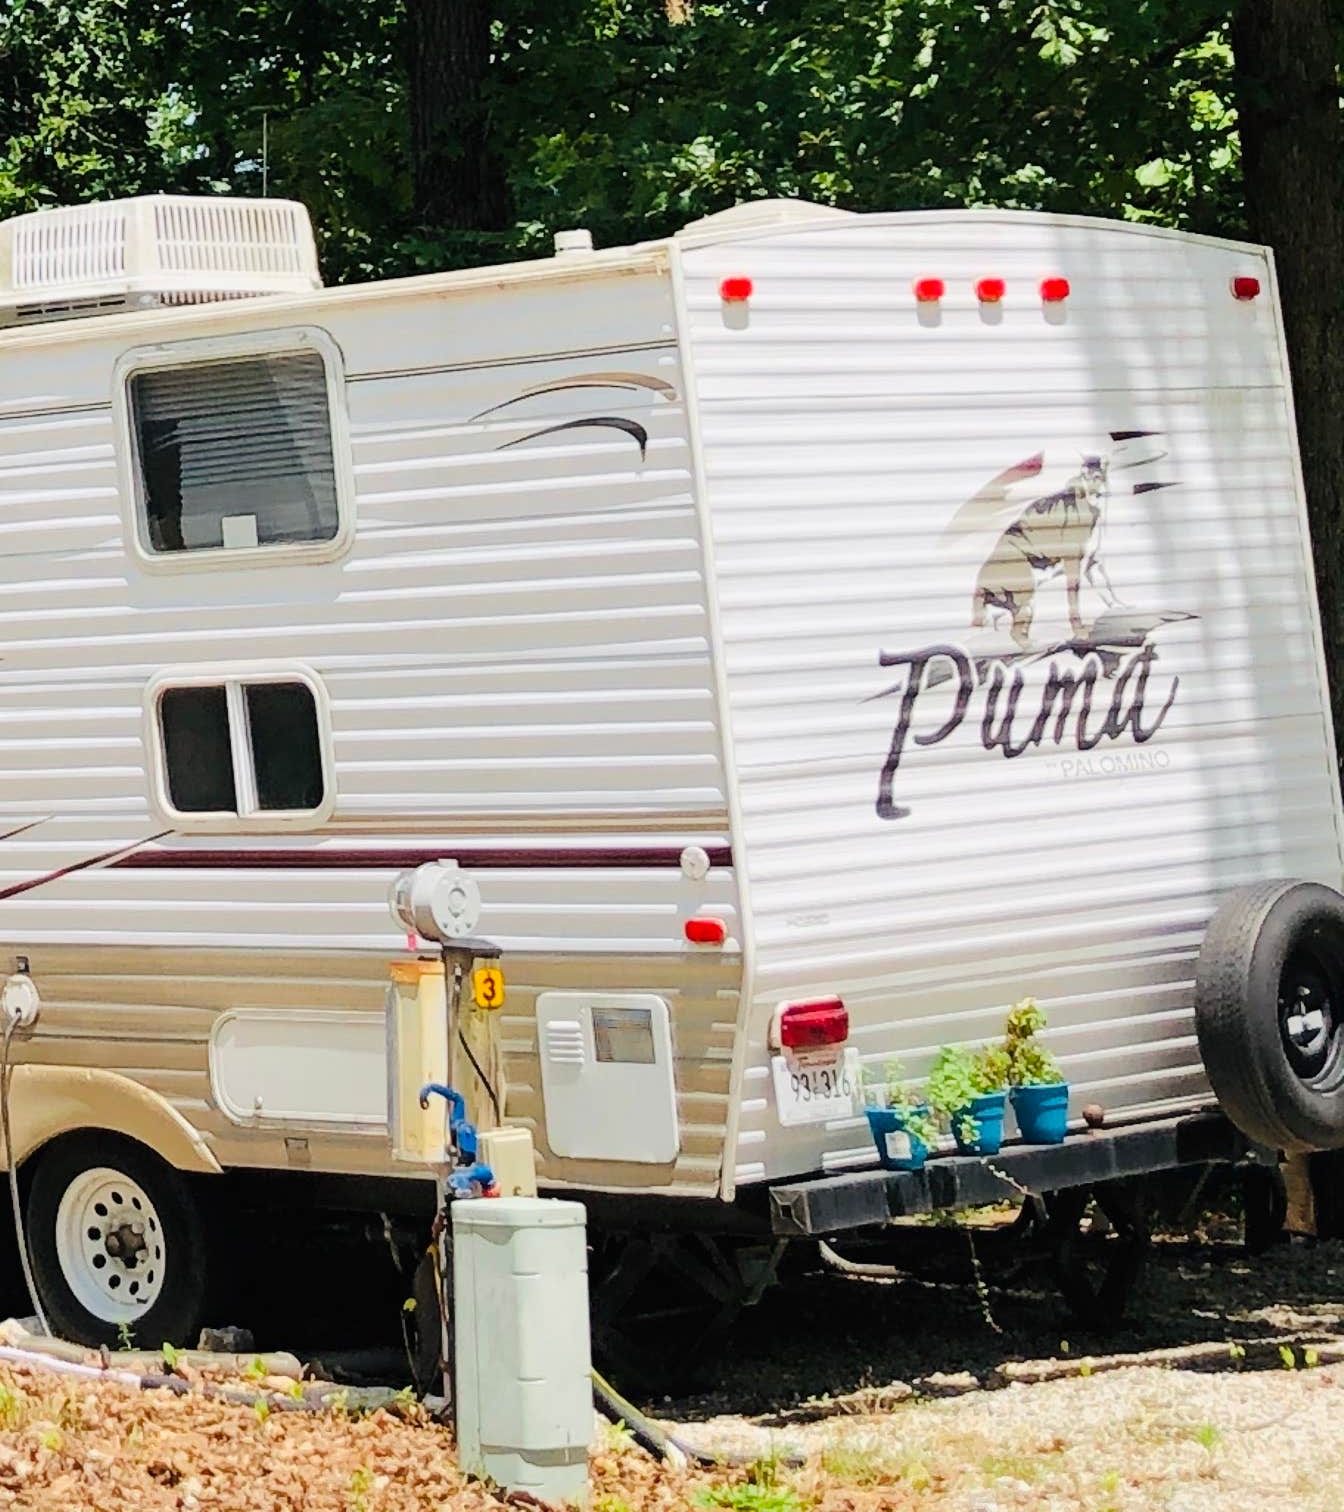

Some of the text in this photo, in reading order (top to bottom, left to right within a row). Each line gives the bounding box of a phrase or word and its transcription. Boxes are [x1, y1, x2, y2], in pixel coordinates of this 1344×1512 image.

[875, 643, 1180, 821] Puma
[1059, 749, 1171, 777] PALOMINO
[482, 976, 496, 1001] 3
